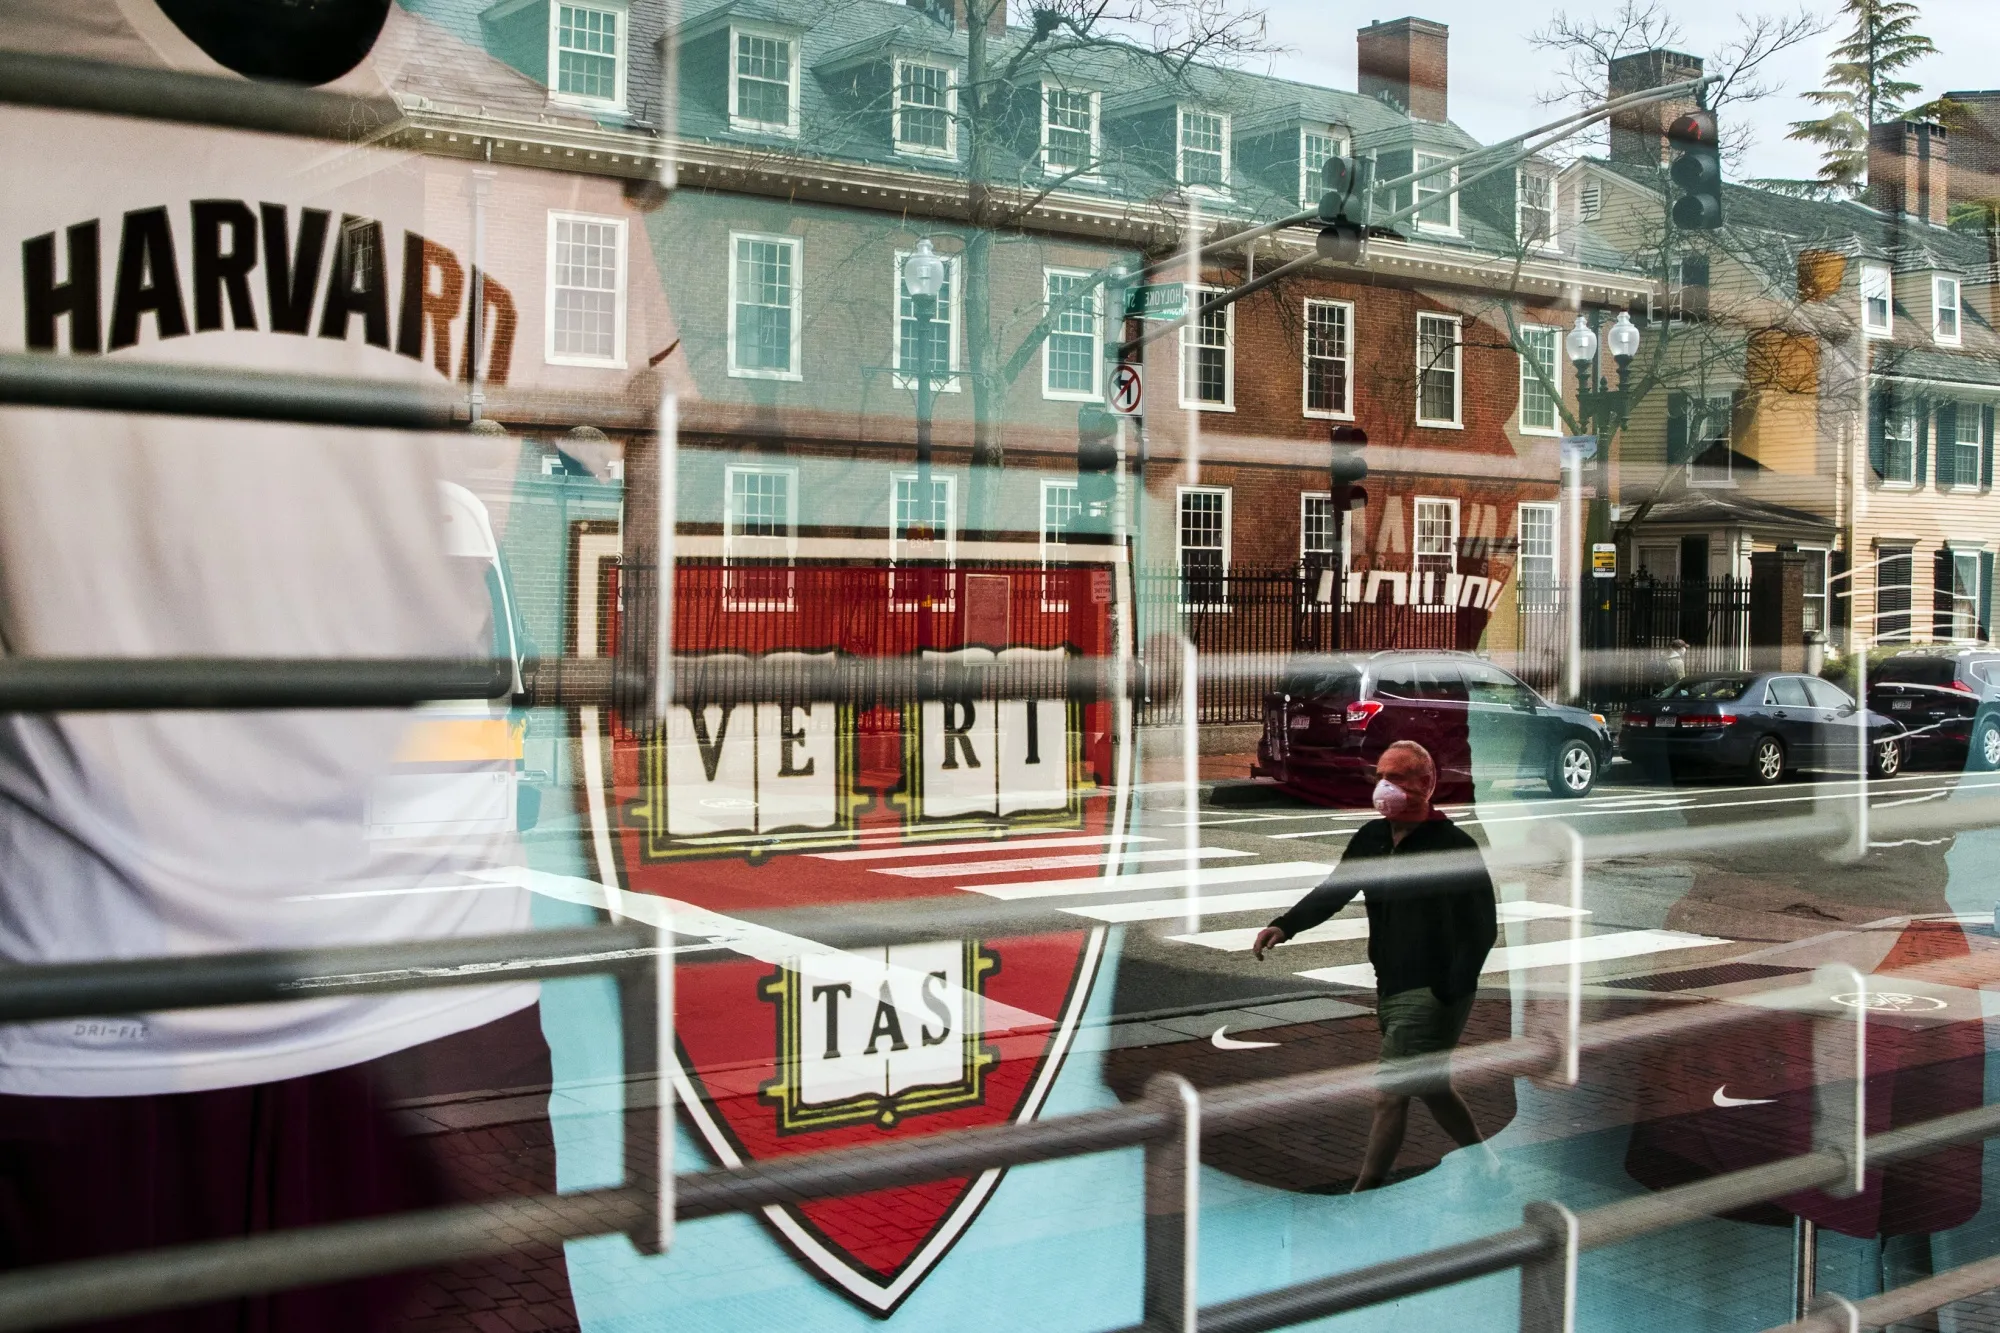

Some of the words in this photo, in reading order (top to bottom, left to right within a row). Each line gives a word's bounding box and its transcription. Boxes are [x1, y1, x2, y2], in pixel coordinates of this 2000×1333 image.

[22, 197, 519, 386] HARVARD
[74, 1023, 148, 1039] DRI-FIT
[812, 970, 951, 1060] TAS
